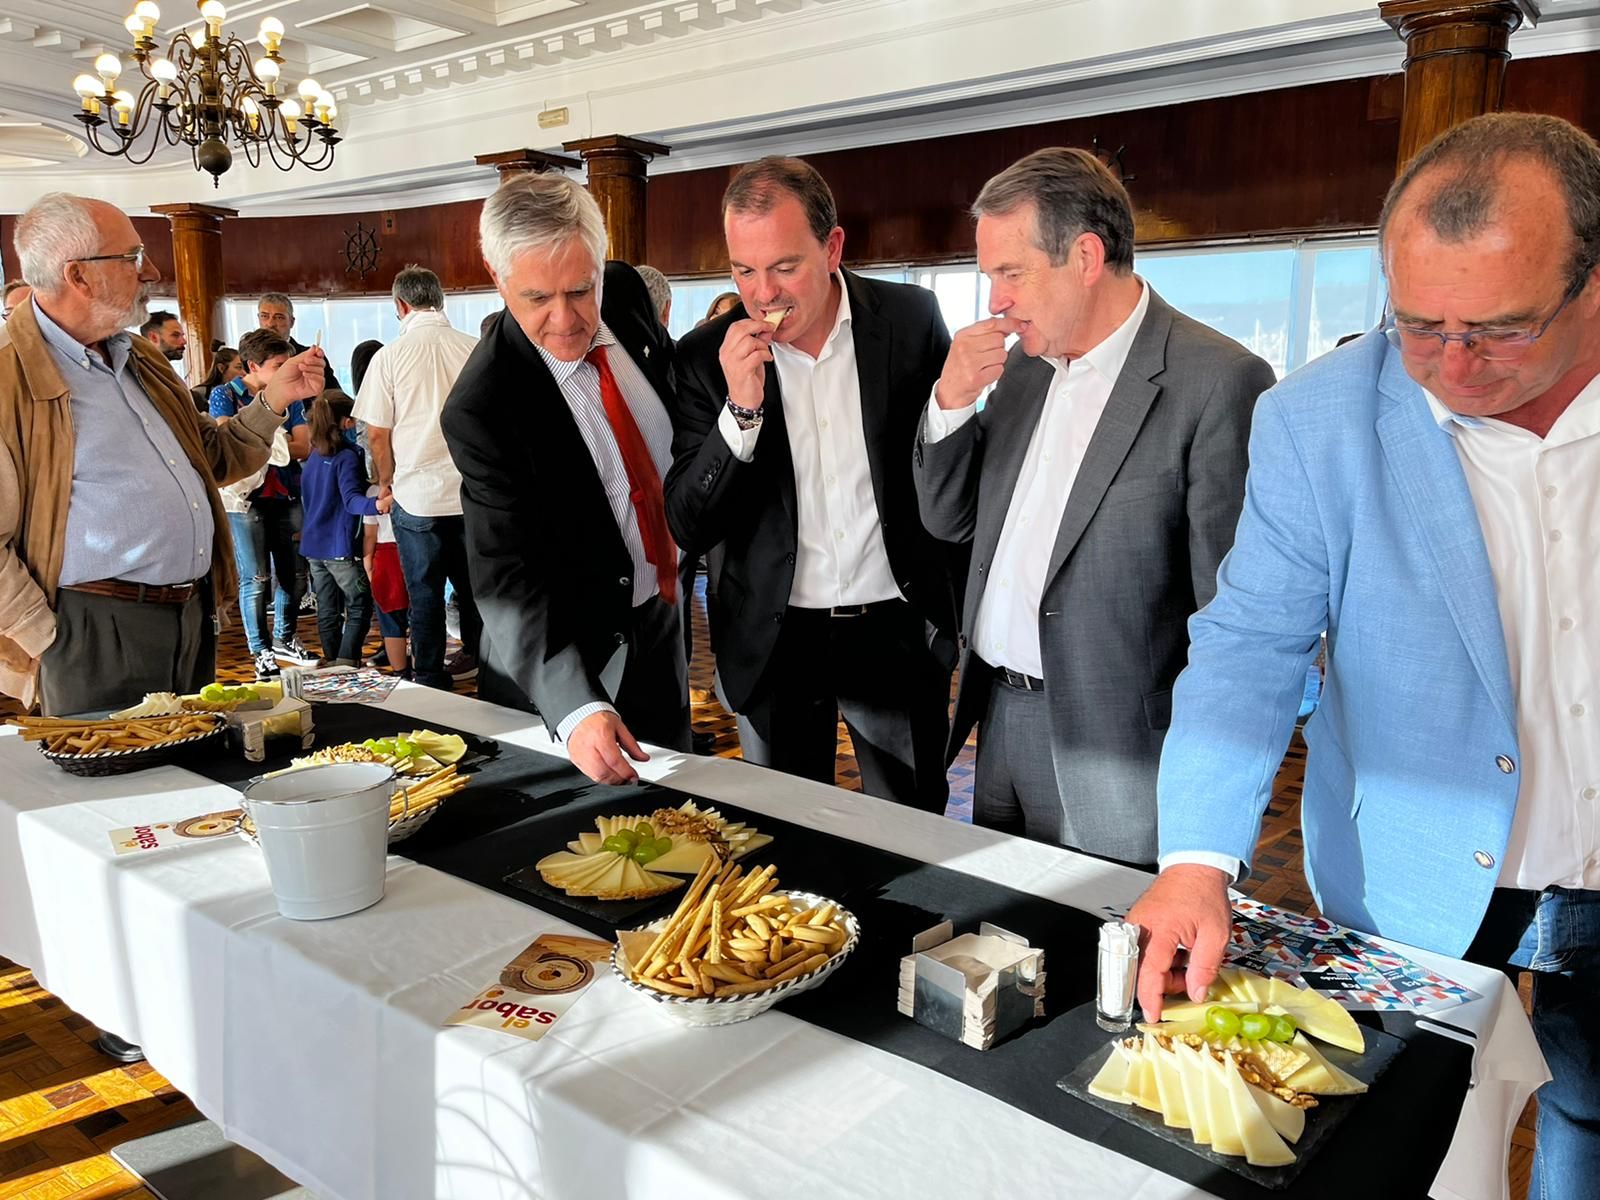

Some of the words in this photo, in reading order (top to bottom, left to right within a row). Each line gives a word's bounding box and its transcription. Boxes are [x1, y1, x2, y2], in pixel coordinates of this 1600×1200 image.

[132, 825, 159, 849] sabor
[461, 999, 557, 1024] sabor
[501, 1016, 530, 1029] el
